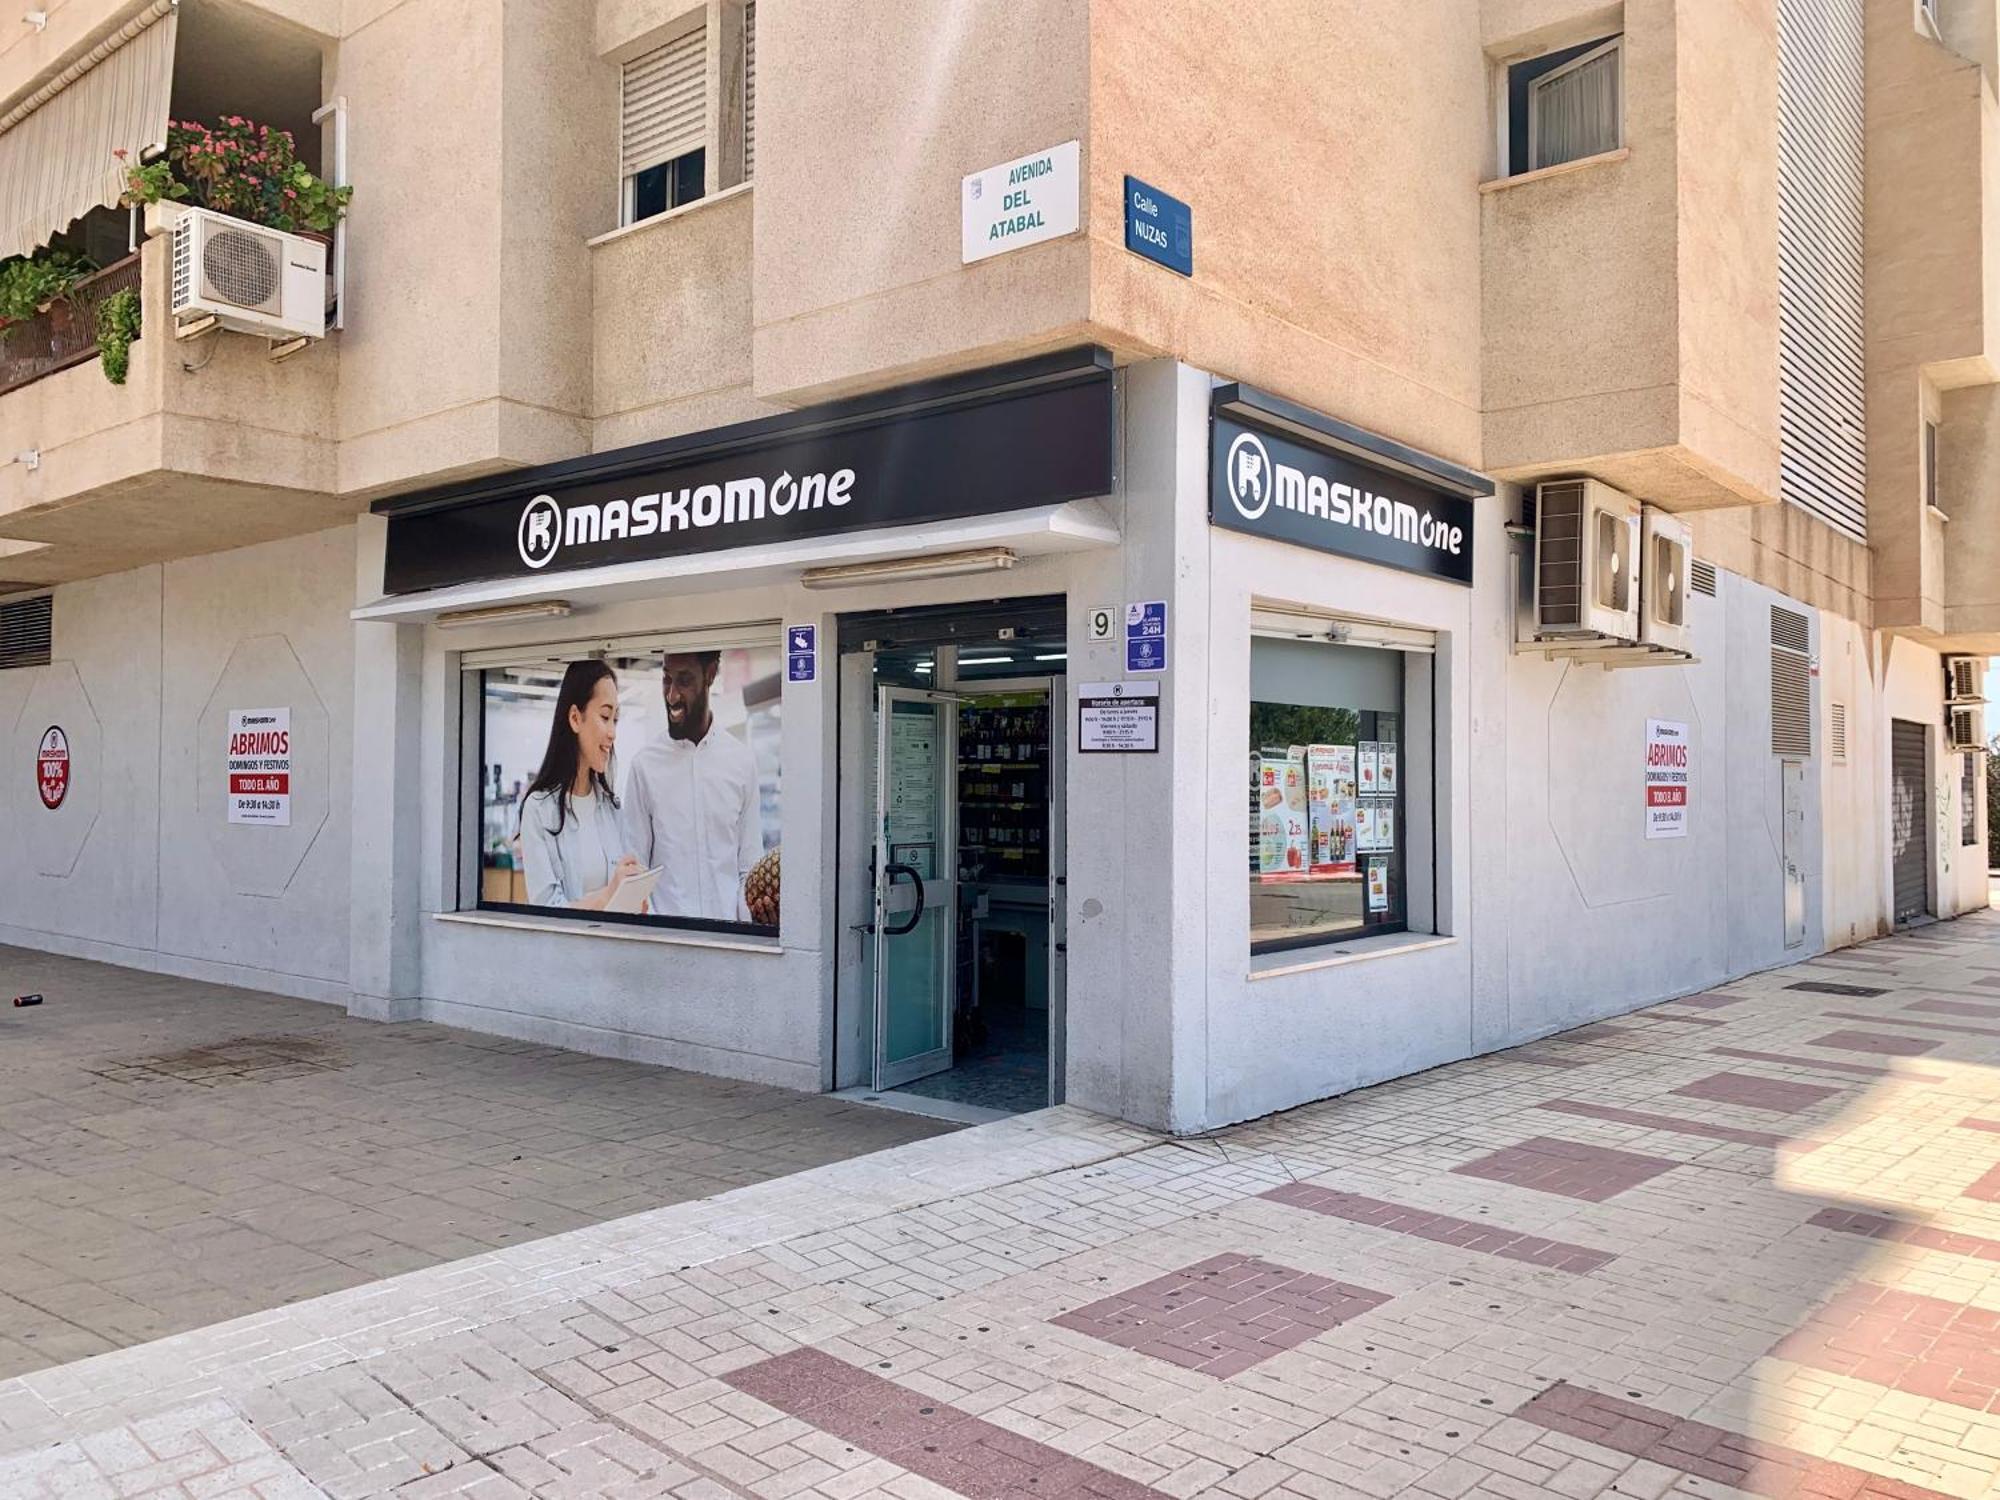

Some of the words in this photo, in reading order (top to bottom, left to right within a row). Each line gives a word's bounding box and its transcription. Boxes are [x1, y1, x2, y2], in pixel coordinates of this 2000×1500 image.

[1008, 156, 1053, 187] AVENIDA
[1003, 188, 1031, 212] DEL
[1134, 191, 1159, 218] Calle
[989, 210, 1045, 241] ATABAL
[1135, 220, 1168, 249] NUZAS
[1095, 611, 1109, 637] 9
[1142, 625, 1162, 636] 24H
[230, 731, 289, 756] ABRIMOS
[1648, 743, 1687, 768] ABRIMOS
[42, 761, 64, 778] 100%
[229, 760, 258, 771] DOMINGOS
[264, 760, 290, 770] FESTIVOS
[239, 780, 257, 791] TODO
[257, 780, 265, 790] EL
[265, 776, 280, 791] AÑO
